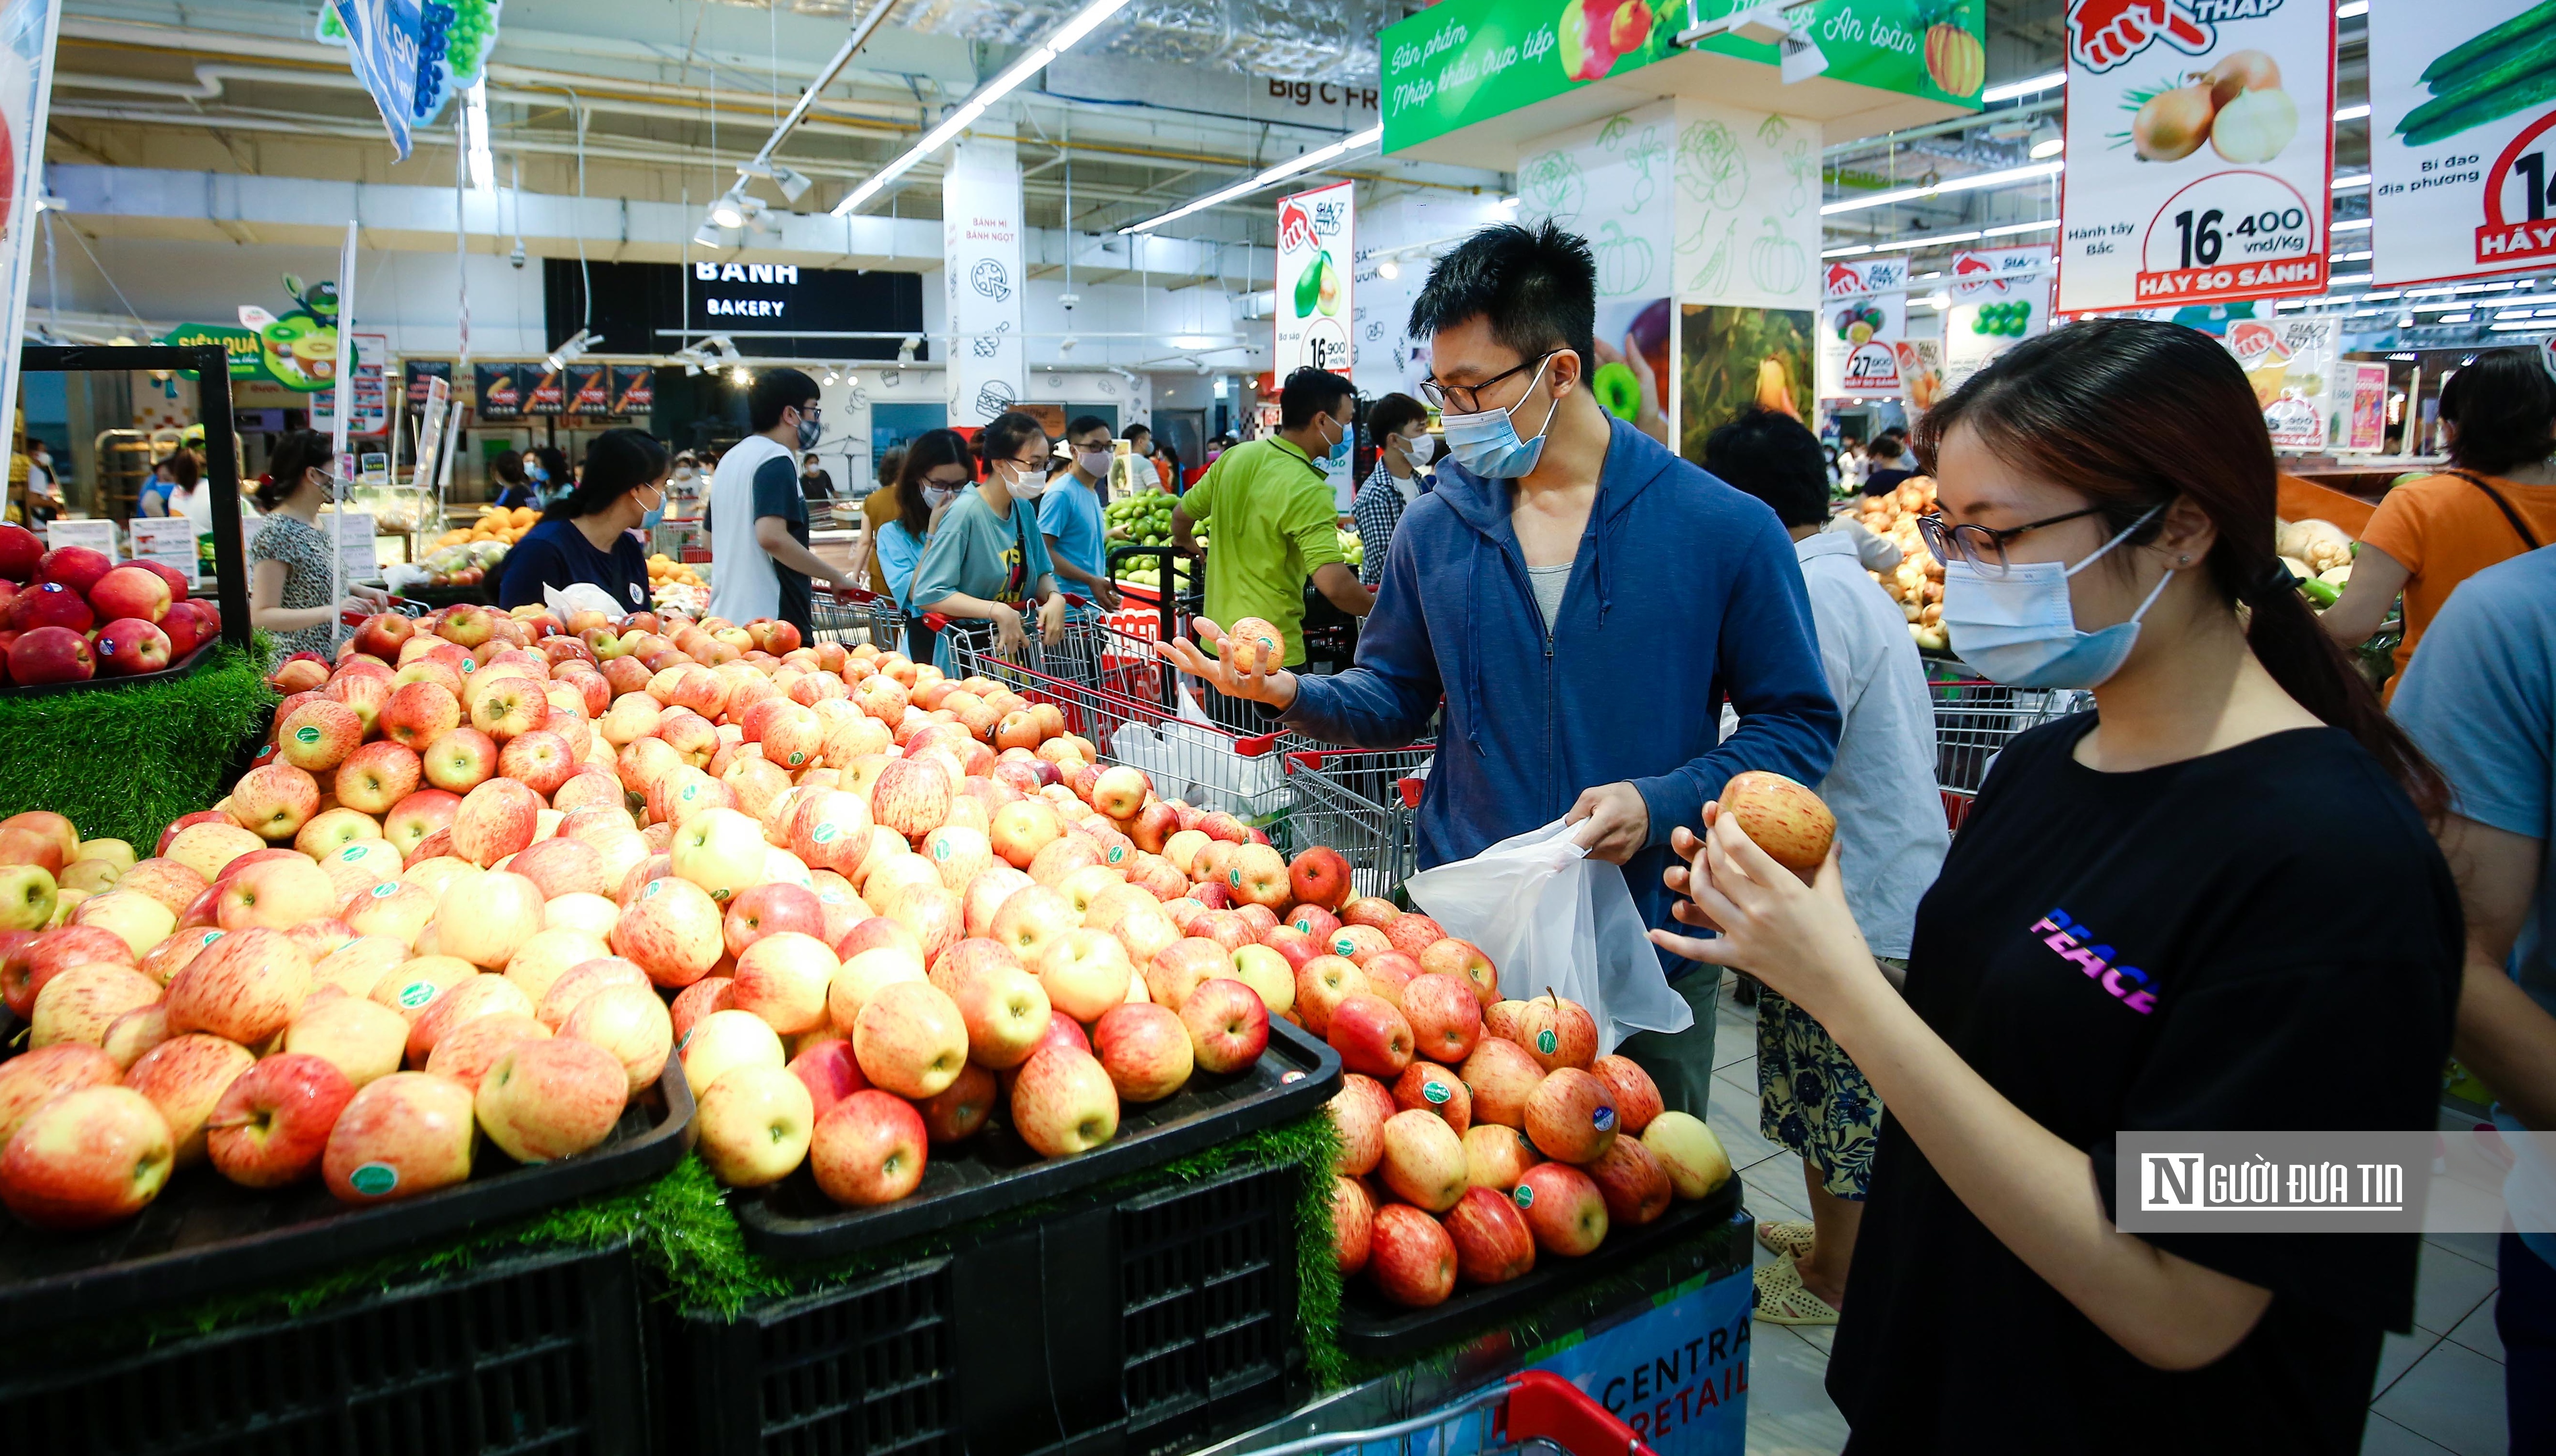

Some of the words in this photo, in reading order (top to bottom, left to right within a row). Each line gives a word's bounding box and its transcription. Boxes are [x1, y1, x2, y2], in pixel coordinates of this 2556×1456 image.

[1823, 7, 1864, 42] An
[1870, 15, 1916, 54] toàn
[1391, 42, 1420, 76] Sản
[1421, 17, 1468, 67] phẩm
[1393, 78, 1435, 117] Nhập
[1436, 51, 1478, 92] khẩu
[1482, 45, 1518, 76] trực
[1523, 22, 1556, 64] tiếp
[1269, 77, 1311, 106] Big
[1319, 82, 1337, 105] C
[2421, 158, 2439, 172] Bí
[2378, 182, 2404, 196] địa
[2410, 170, 2479, 193] phương
[973, 216, 995, 228] BÁNH
[2069, 225, 2106, 241] Hành
[2111, 222, 2134, 236] tây
[966, 229, 989, 240] BÁNH
[991, 232, 1014, 244] NGỌT
[2086, 242, 2114, 256] Bắc
[2244, 235, 2305, 254] vnd/Kg
[2195, 271, 2233, 291] SO
[2237, 260, 2316, 287] SÁNH
[707, 298, 785, 318] BAKERY
[2029, 907, 2162, 1016] PEACE
[1629, 1360, 1749, 1443] RETAIL
